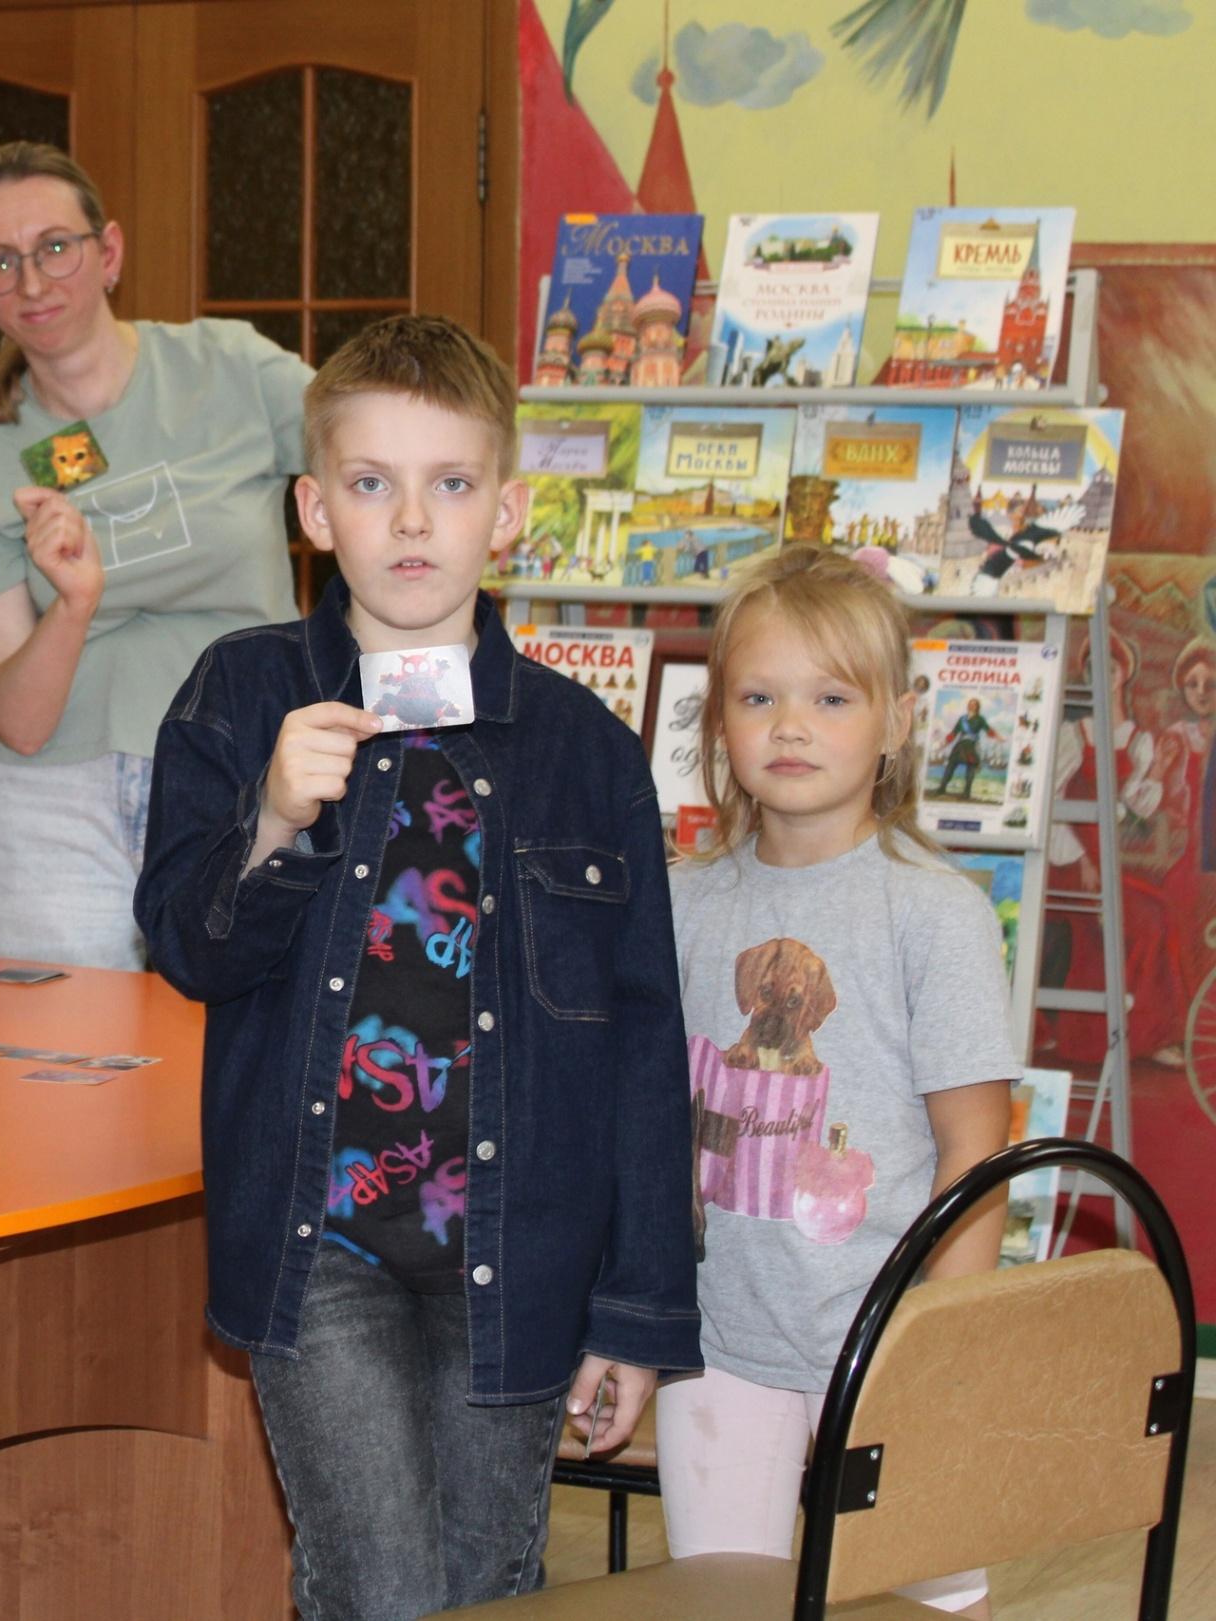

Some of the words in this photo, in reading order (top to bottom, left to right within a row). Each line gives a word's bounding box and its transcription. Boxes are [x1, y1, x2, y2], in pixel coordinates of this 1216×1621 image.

[953, 243, 1022, 264] КРЕМЛЬ
[755, 283, 831, 296] МОСКВА
[845, 444, 900, 462] ВДНХ
[1006, 446, 1060, 460] КОЛЬЦА
[1002, 460, 1061, 475] МОСКВЫ
[523, 642, 634, 668] МОСКВА
[946, 655, 1018, 668] СЕВЕРНАЯ
[937, 669, 1022, 685] СТОЛИЦА
